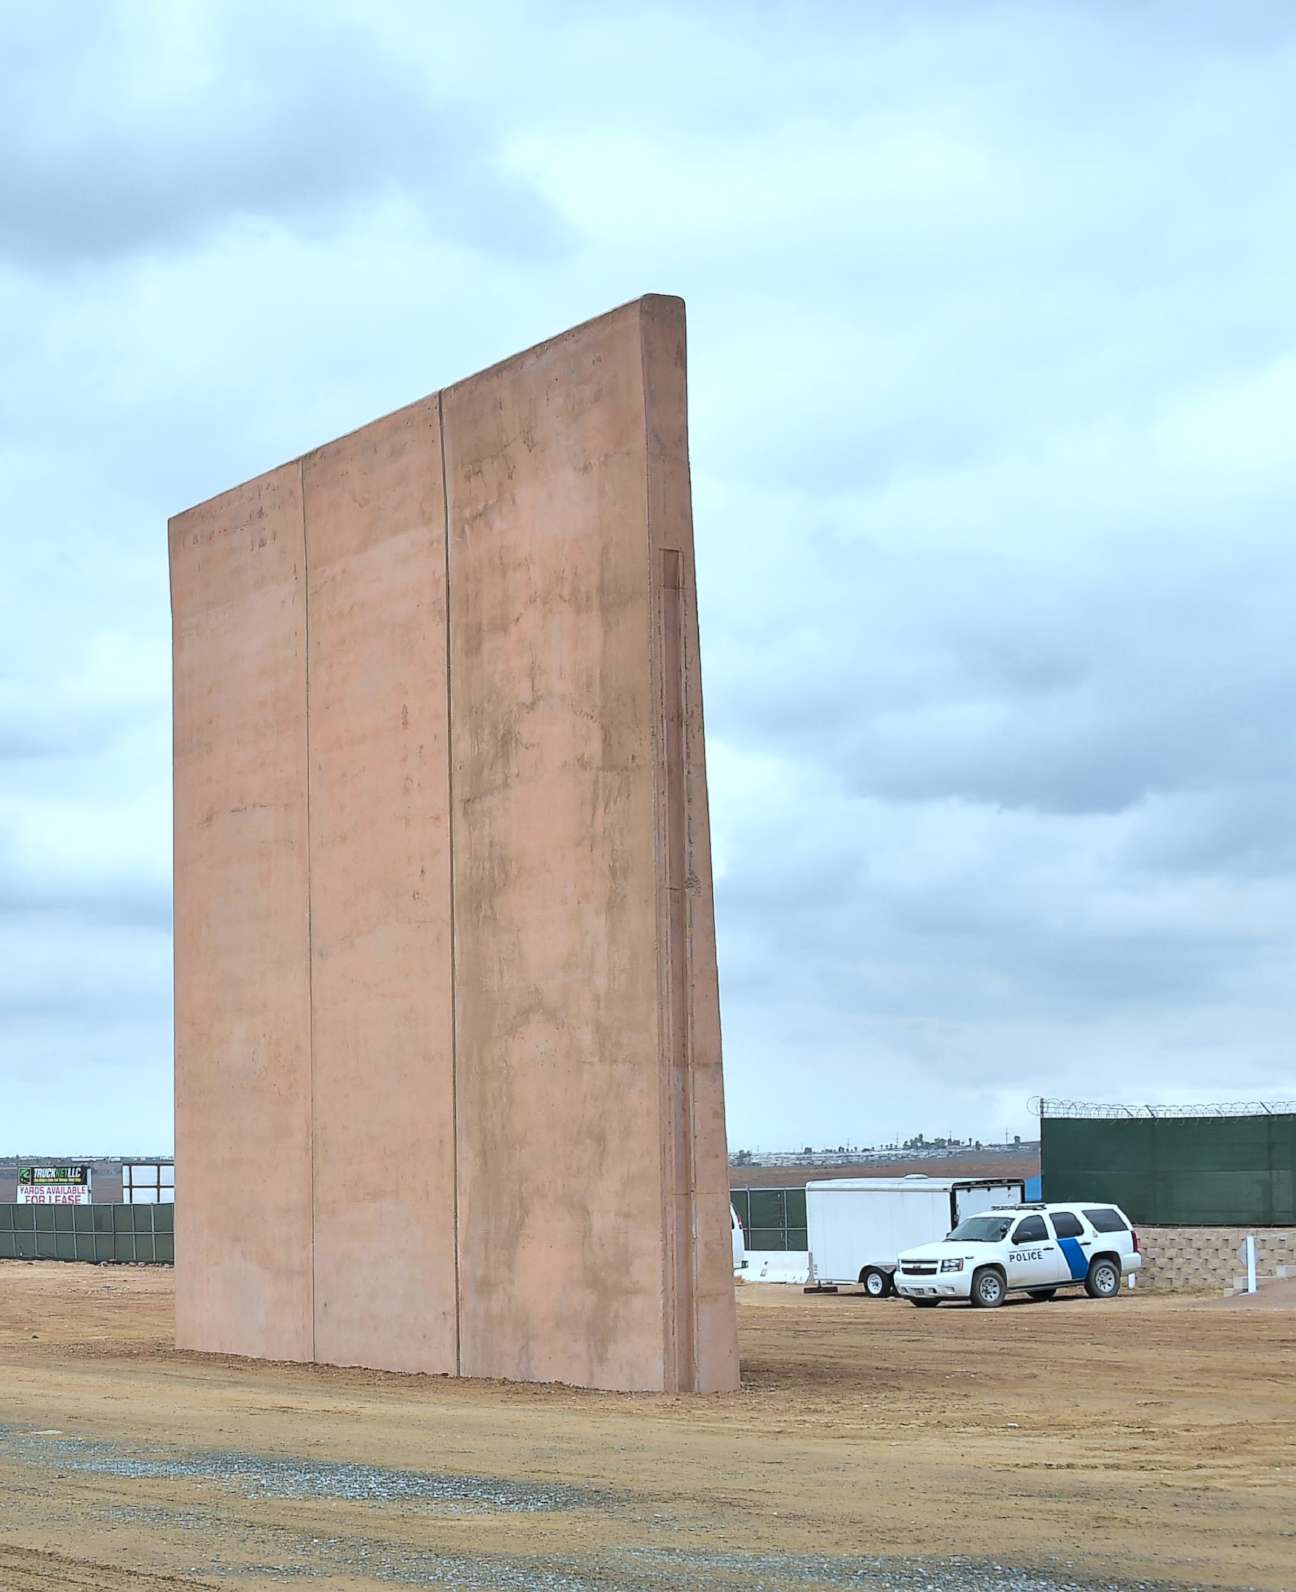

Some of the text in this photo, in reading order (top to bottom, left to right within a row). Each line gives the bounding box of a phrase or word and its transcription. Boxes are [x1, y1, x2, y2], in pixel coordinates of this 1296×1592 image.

[20, 1186, 86, 1194] YARDS AVAILABLE
[25, 1195, 81, 1204] FOR LEASE
[1009, 1251, 1043, 1262] POLICE
